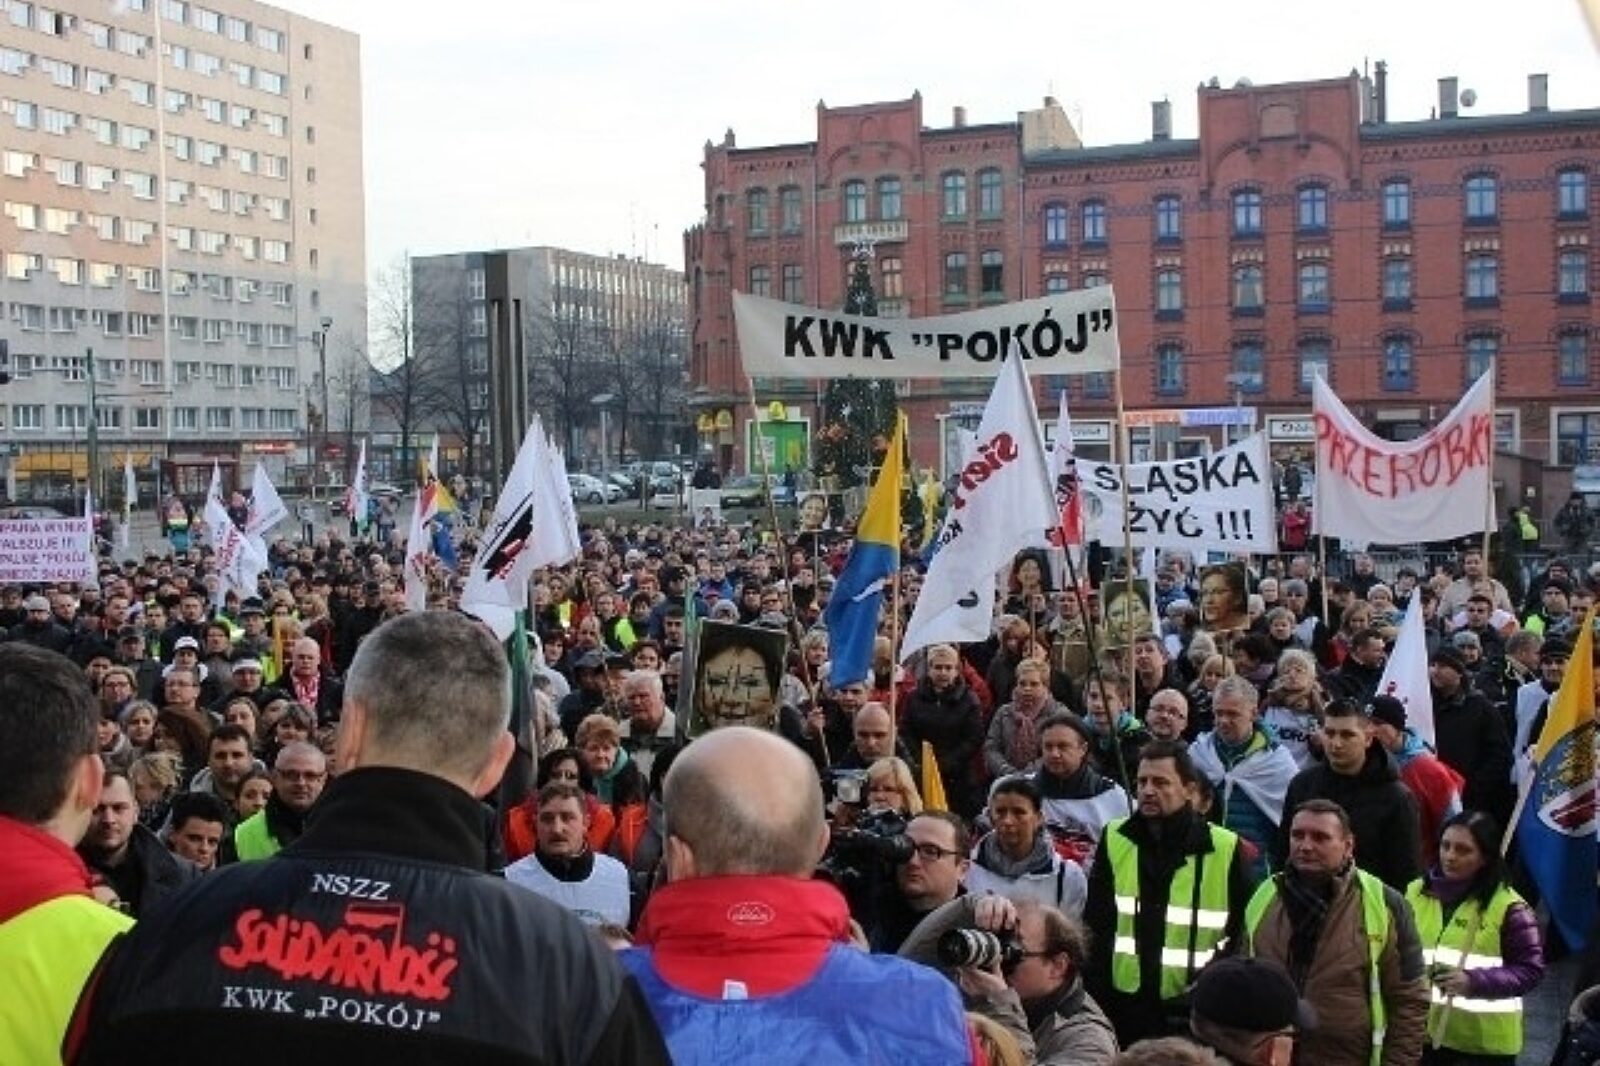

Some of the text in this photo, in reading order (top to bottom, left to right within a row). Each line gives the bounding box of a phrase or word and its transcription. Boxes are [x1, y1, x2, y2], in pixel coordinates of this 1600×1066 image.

[784, 315, 894, 359] KWK
[1215, 508, 1254, 540] !!!
[310, 873, 392, 901] NSZZ
[221, 985, 296, 1014] KWK
